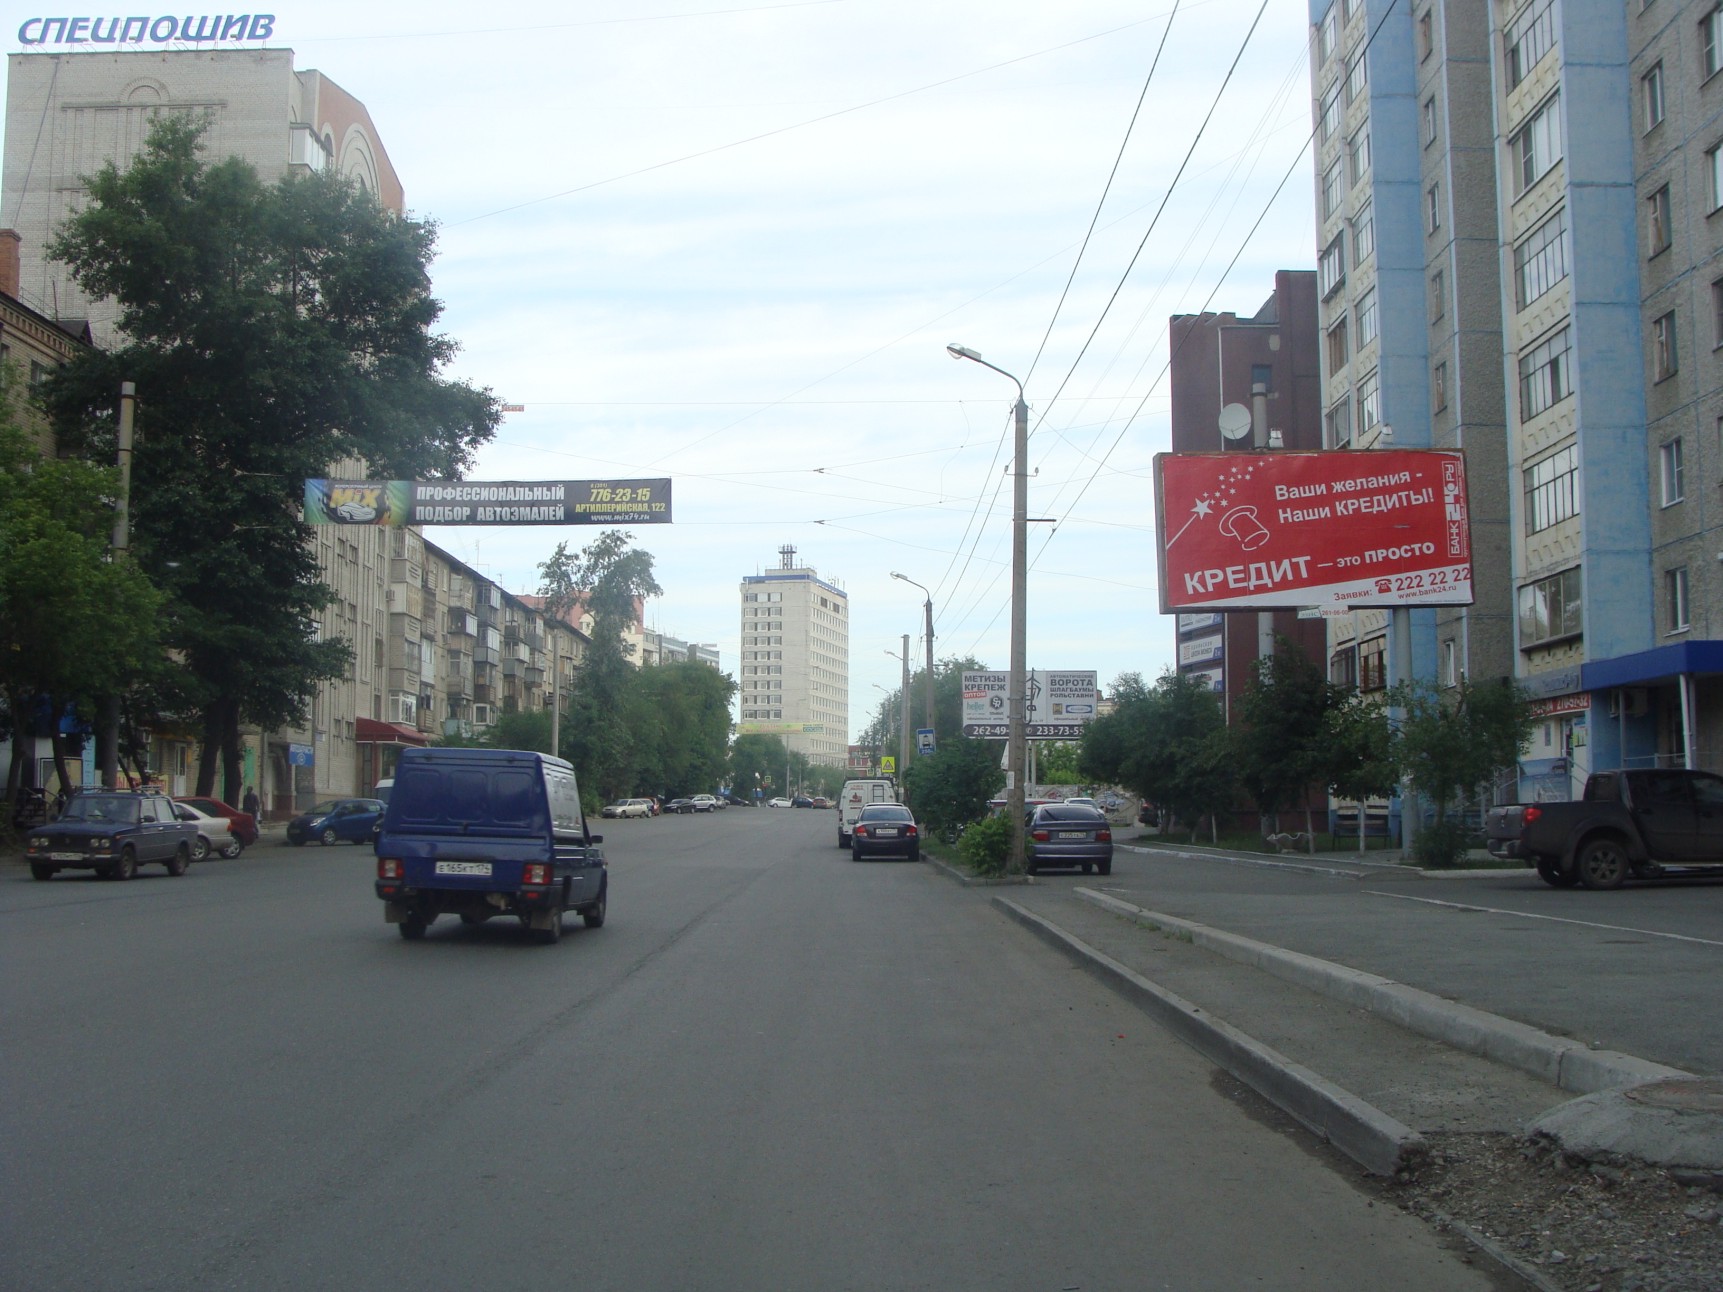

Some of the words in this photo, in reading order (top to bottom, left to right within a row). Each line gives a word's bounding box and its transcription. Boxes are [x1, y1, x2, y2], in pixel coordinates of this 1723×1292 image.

[18, 14, 276, 45] СПЕЦПОШИВ
[416, 484, 565, 501] ПРОФЕССИОНАЛЬНЫЙ
[1275, 483, 1327, 501] Ваши
[1331, 471, 1411, 494] желания
[589, 487, 651, 502] 776-23-15
[575, 502, 650, 513] АРТИЛЛЕРИЙСКАЯ,
[651, 502, 666, 512] 122
[1278, 506, 1332, 524] Наши
[1335, 487, 1435, 517] КРЕДИТЫ!
[415, 506, 471, 523] ПОДБОР
[476, 504, 565, 521] АВТОЭМАЛЕЙ
[590, 512, 650, 521] www.mix74.ru
[1183, 556, 1312, 595] КРЕДИТ
[1336, 555, 1362, 569] это
[1364, 541, 1436, 565] ПРОСТО
[1333, 588, 1374, 601] Заявки:
[1395, 574, 1425, 592] 222
[1428, 570, 1449, 586] 22
[1452, 566, 1472, 582] 22
[1398, 585, 1457, 600] www.bank24.ru
[964, 675, 1006, 683] МЕТИЗЫ
[1050, 679, 1094, 687] ВОРОТА
[964, 683, 1006, 691] КРЕПЕЖ
[972, 726, 1010, 735] 262-49-
[1036, 726, 1085, 735] 233-73-55
